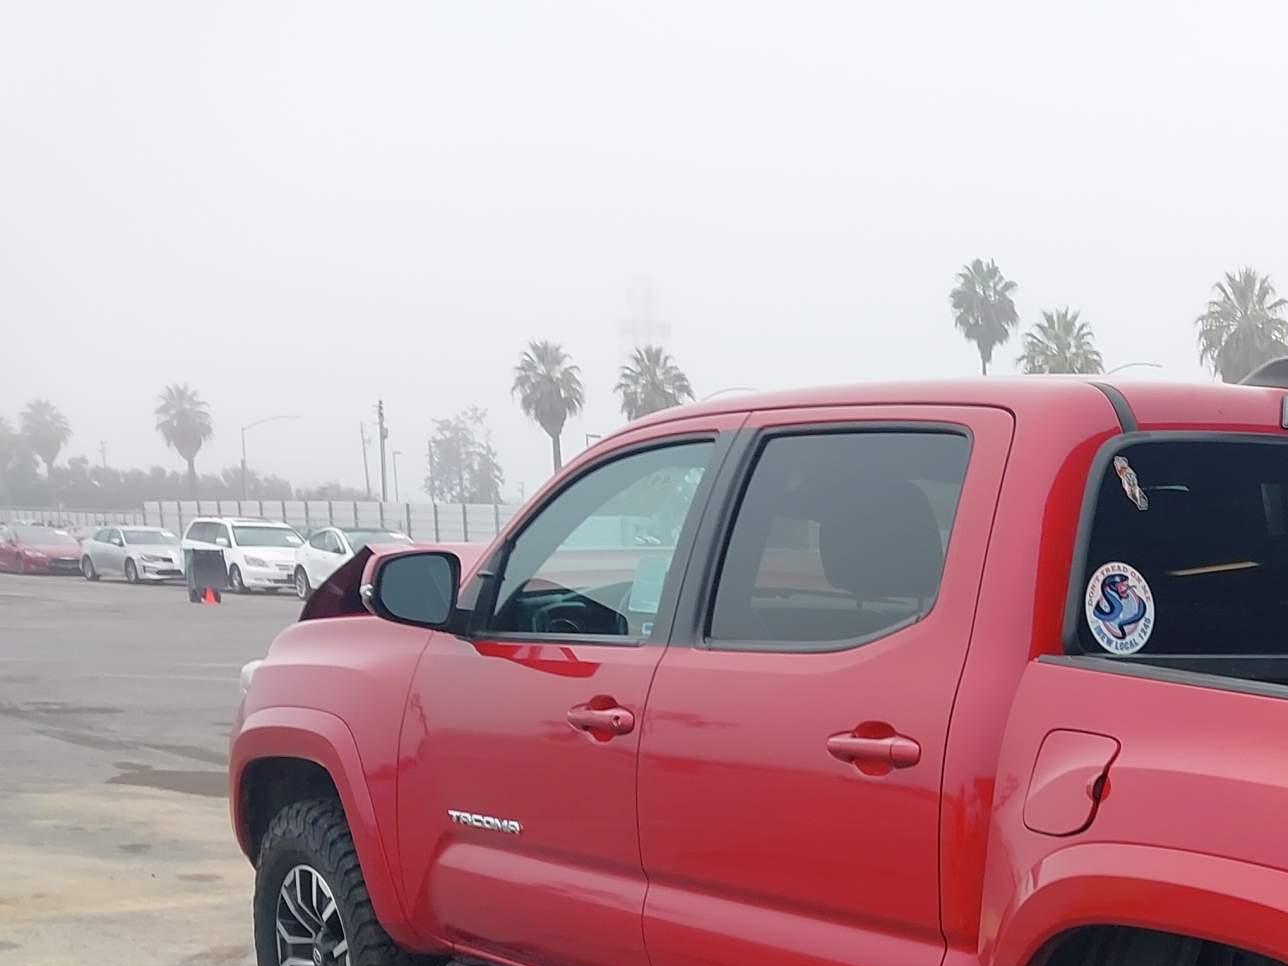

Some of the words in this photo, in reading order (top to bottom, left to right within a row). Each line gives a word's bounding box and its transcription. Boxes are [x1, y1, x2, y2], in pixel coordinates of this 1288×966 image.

[1101, 565, 1129, 577] TREAD
[1130, 571, 1143, 585] ON
[1115, 638, 1139, 651] LOCAL
[447, 809, 523, 835] TACOMA
